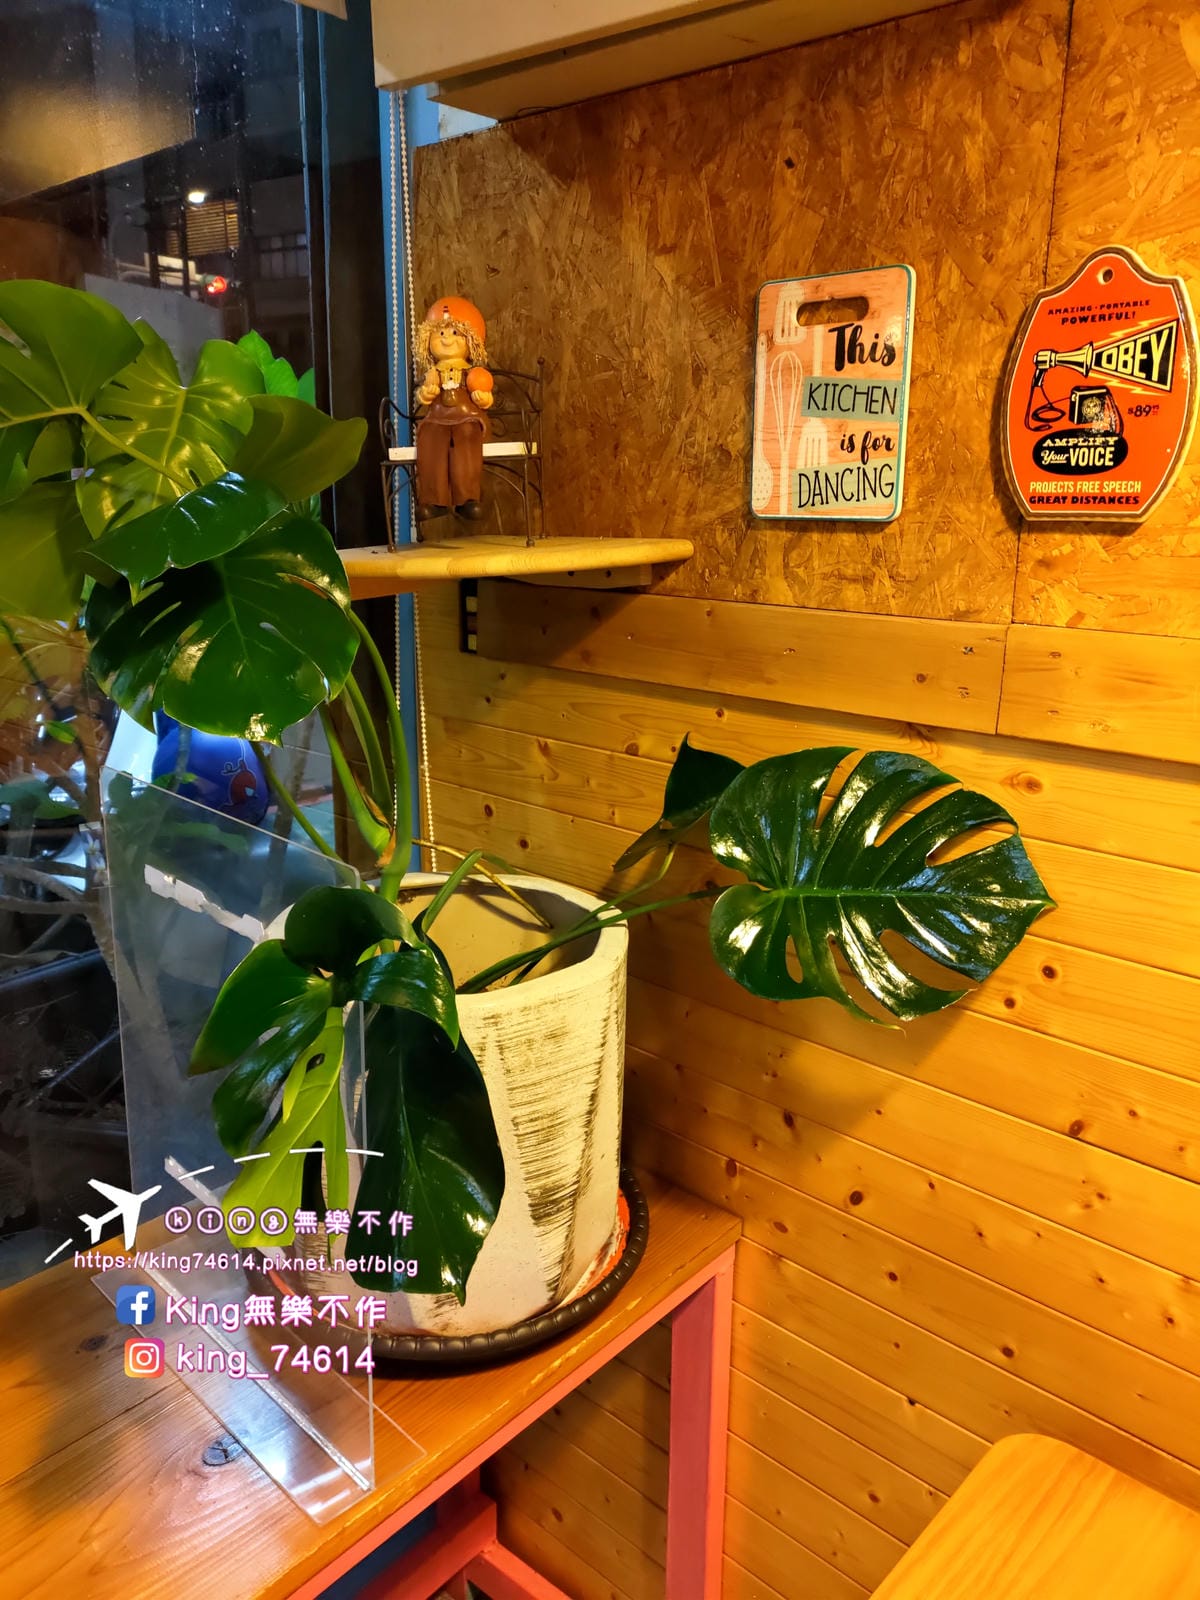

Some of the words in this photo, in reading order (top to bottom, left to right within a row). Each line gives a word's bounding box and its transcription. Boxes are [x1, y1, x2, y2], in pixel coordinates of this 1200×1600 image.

[1047, 305, 1093, 316] AMAZING
[1099, 299, 1151, 311] PORTABLE
[1061, 311, 1136, 326] POWERFUL!
[828, 322, 897, 372] This
[1100, 328, 1170, 382] OBEY
[807, 382, 898, 416] KITCHEN
[839, 431, 856, 453] is
[860, 430, 896, 465] for
[1042, 436, 1119, 447] AMPLIFY
[1040, 449, 1070, 465] Your
[1069, 446, 1115, 467] VOICE
[797, 463, 896, 509] DANCING
[1029, 481, 1075, 493] PROJECTS
[1077, 481, 1100, 493] FREE
[1102, 481, 1142, 493] SPEECH
[1028, 495, 1068, 505] GREAT
[1071, 495, 1140, 505] DISTANCES
